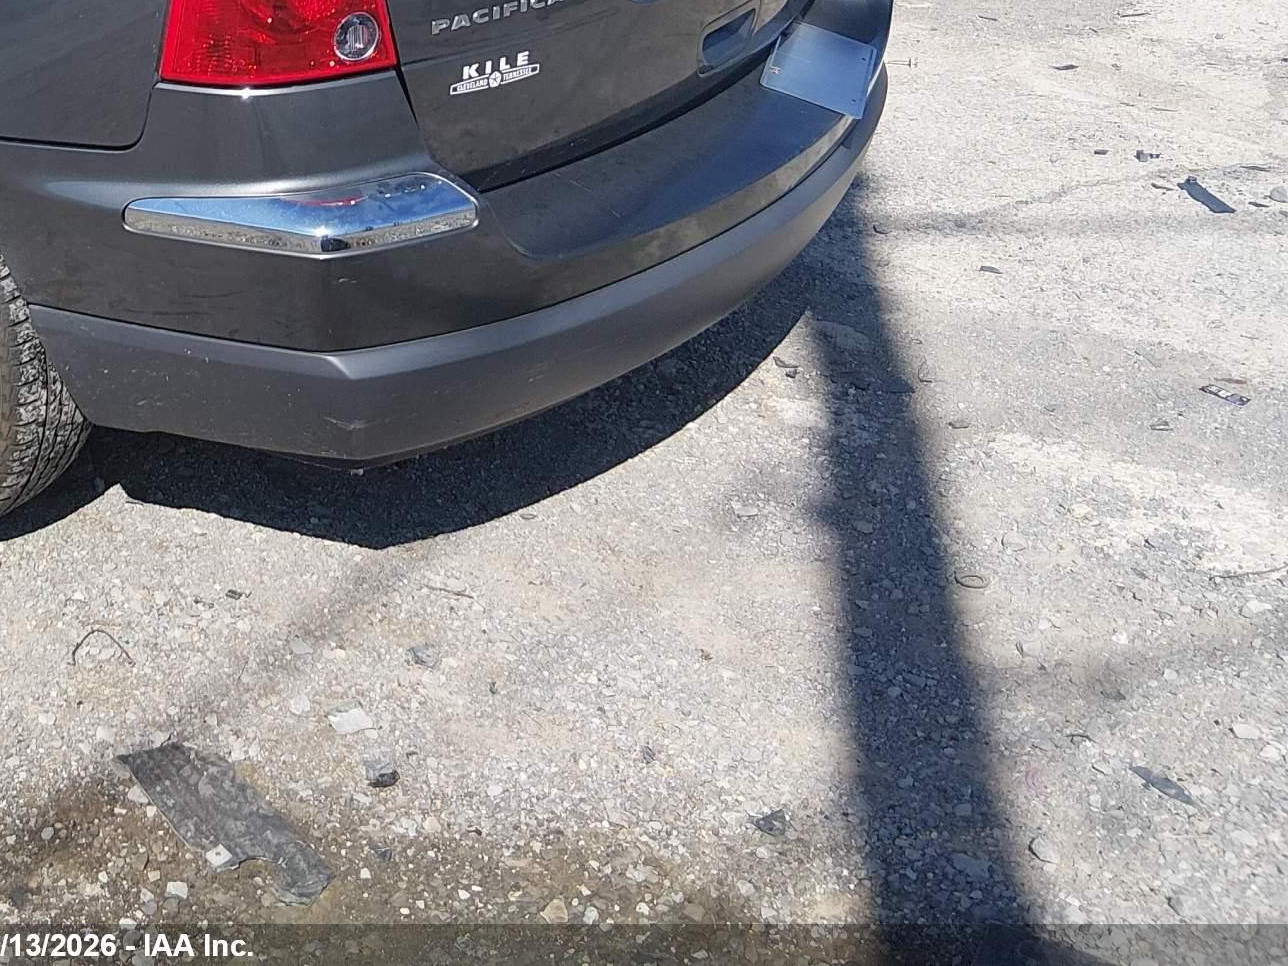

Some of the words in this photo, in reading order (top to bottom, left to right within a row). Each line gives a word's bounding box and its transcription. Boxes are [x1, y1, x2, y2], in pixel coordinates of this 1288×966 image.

[456, 78, 489, 92] CLEVELAND
[503, 66, 533, 81] TENNESSEE
[463, 51, 530, 80] KILE
